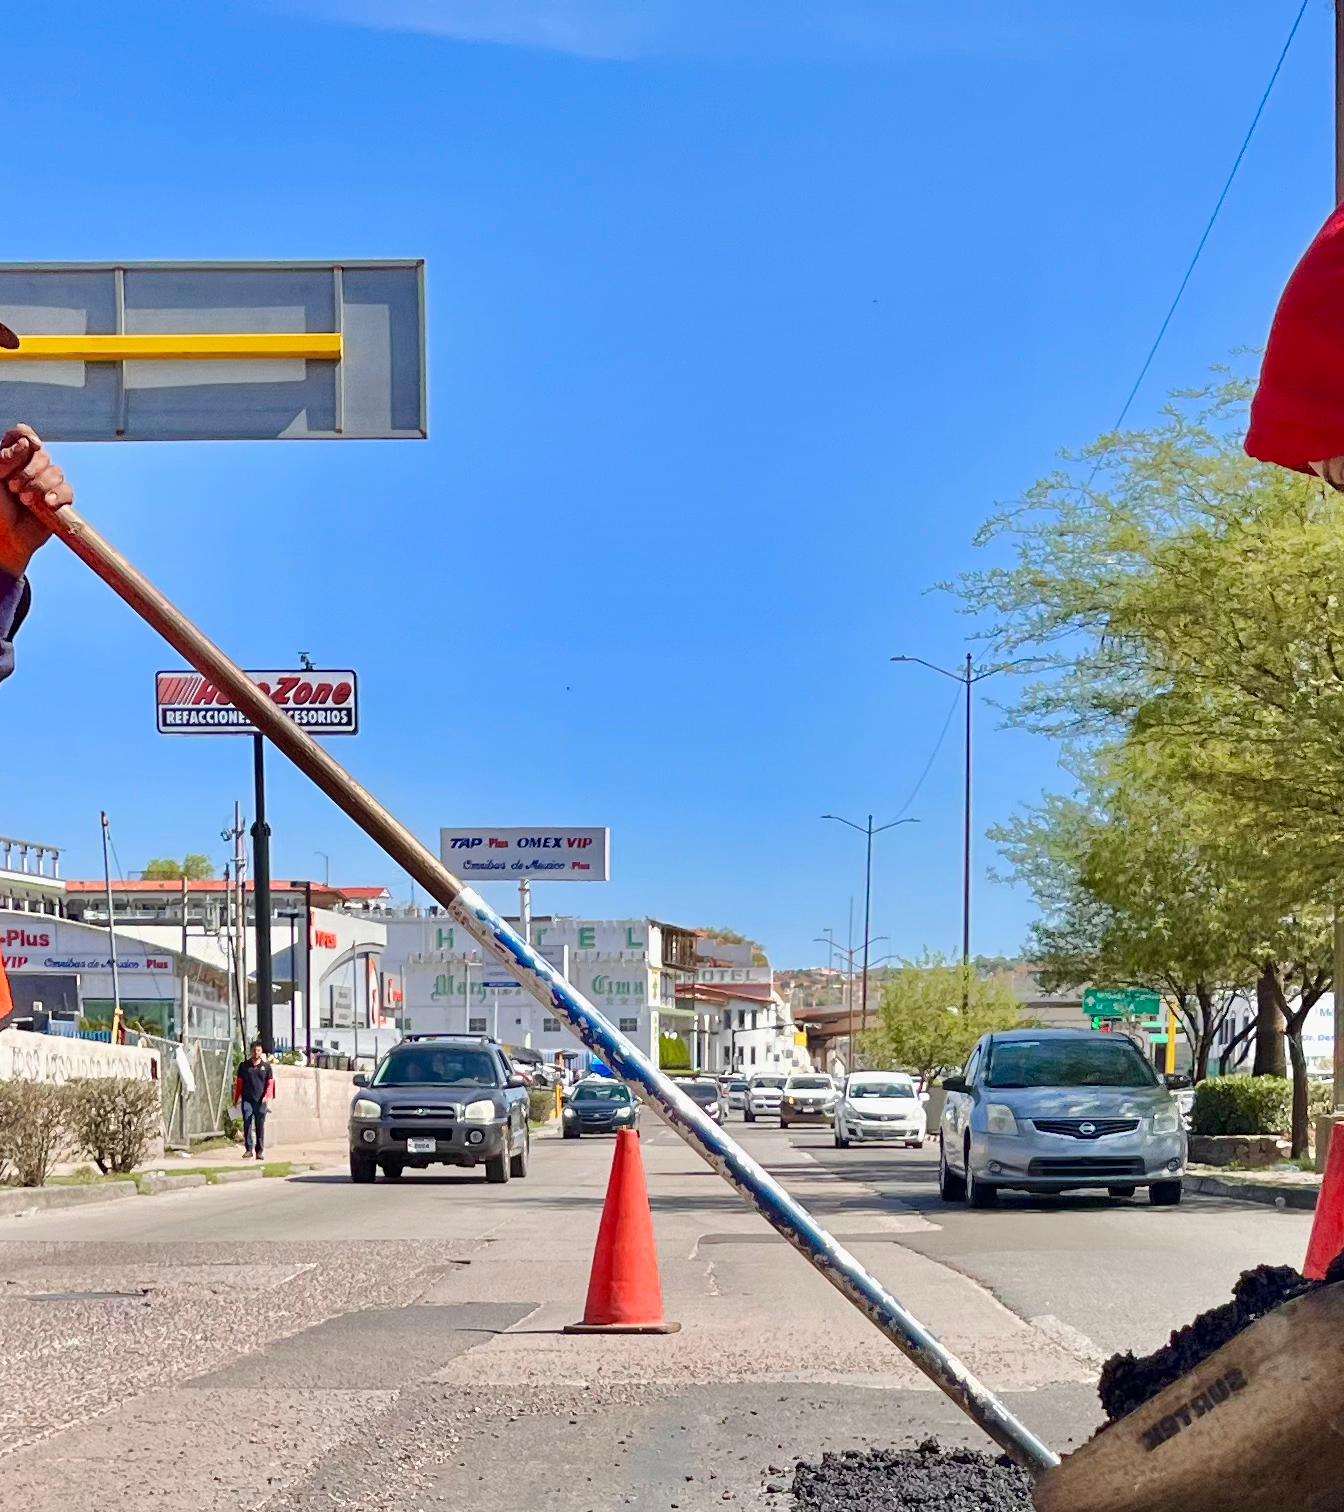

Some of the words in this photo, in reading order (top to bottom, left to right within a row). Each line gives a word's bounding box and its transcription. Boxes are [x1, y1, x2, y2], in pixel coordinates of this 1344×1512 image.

[450, 838, 483, 849] TAP
[517, 837, 562, 849] OMEX
[567, 837, 593, 849] VIP
